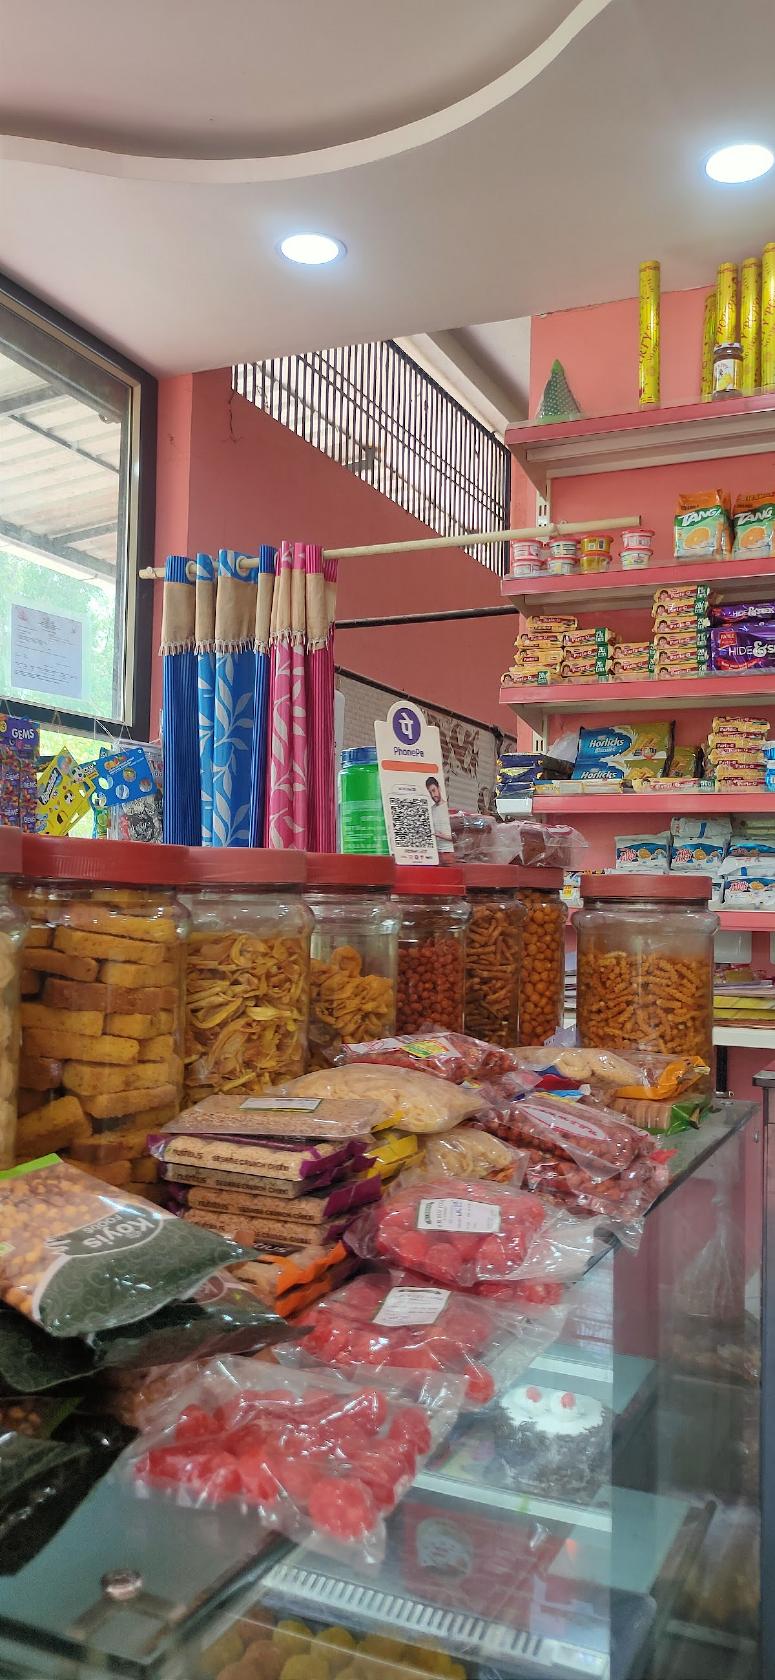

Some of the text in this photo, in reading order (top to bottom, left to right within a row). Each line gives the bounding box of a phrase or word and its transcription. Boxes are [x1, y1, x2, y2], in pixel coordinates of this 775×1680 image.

[678, 508, 718, 527] TANG
[734, 507, 773, 526] TANG
[11, 728, 35, 740] GEMS
[589, 737, 624, 748] Horlicks
[394, 746, 424, 758] PhonePe
[581, 769, 617, 779] Horlicks
[83, 1214, 123, 1234] FOODS
